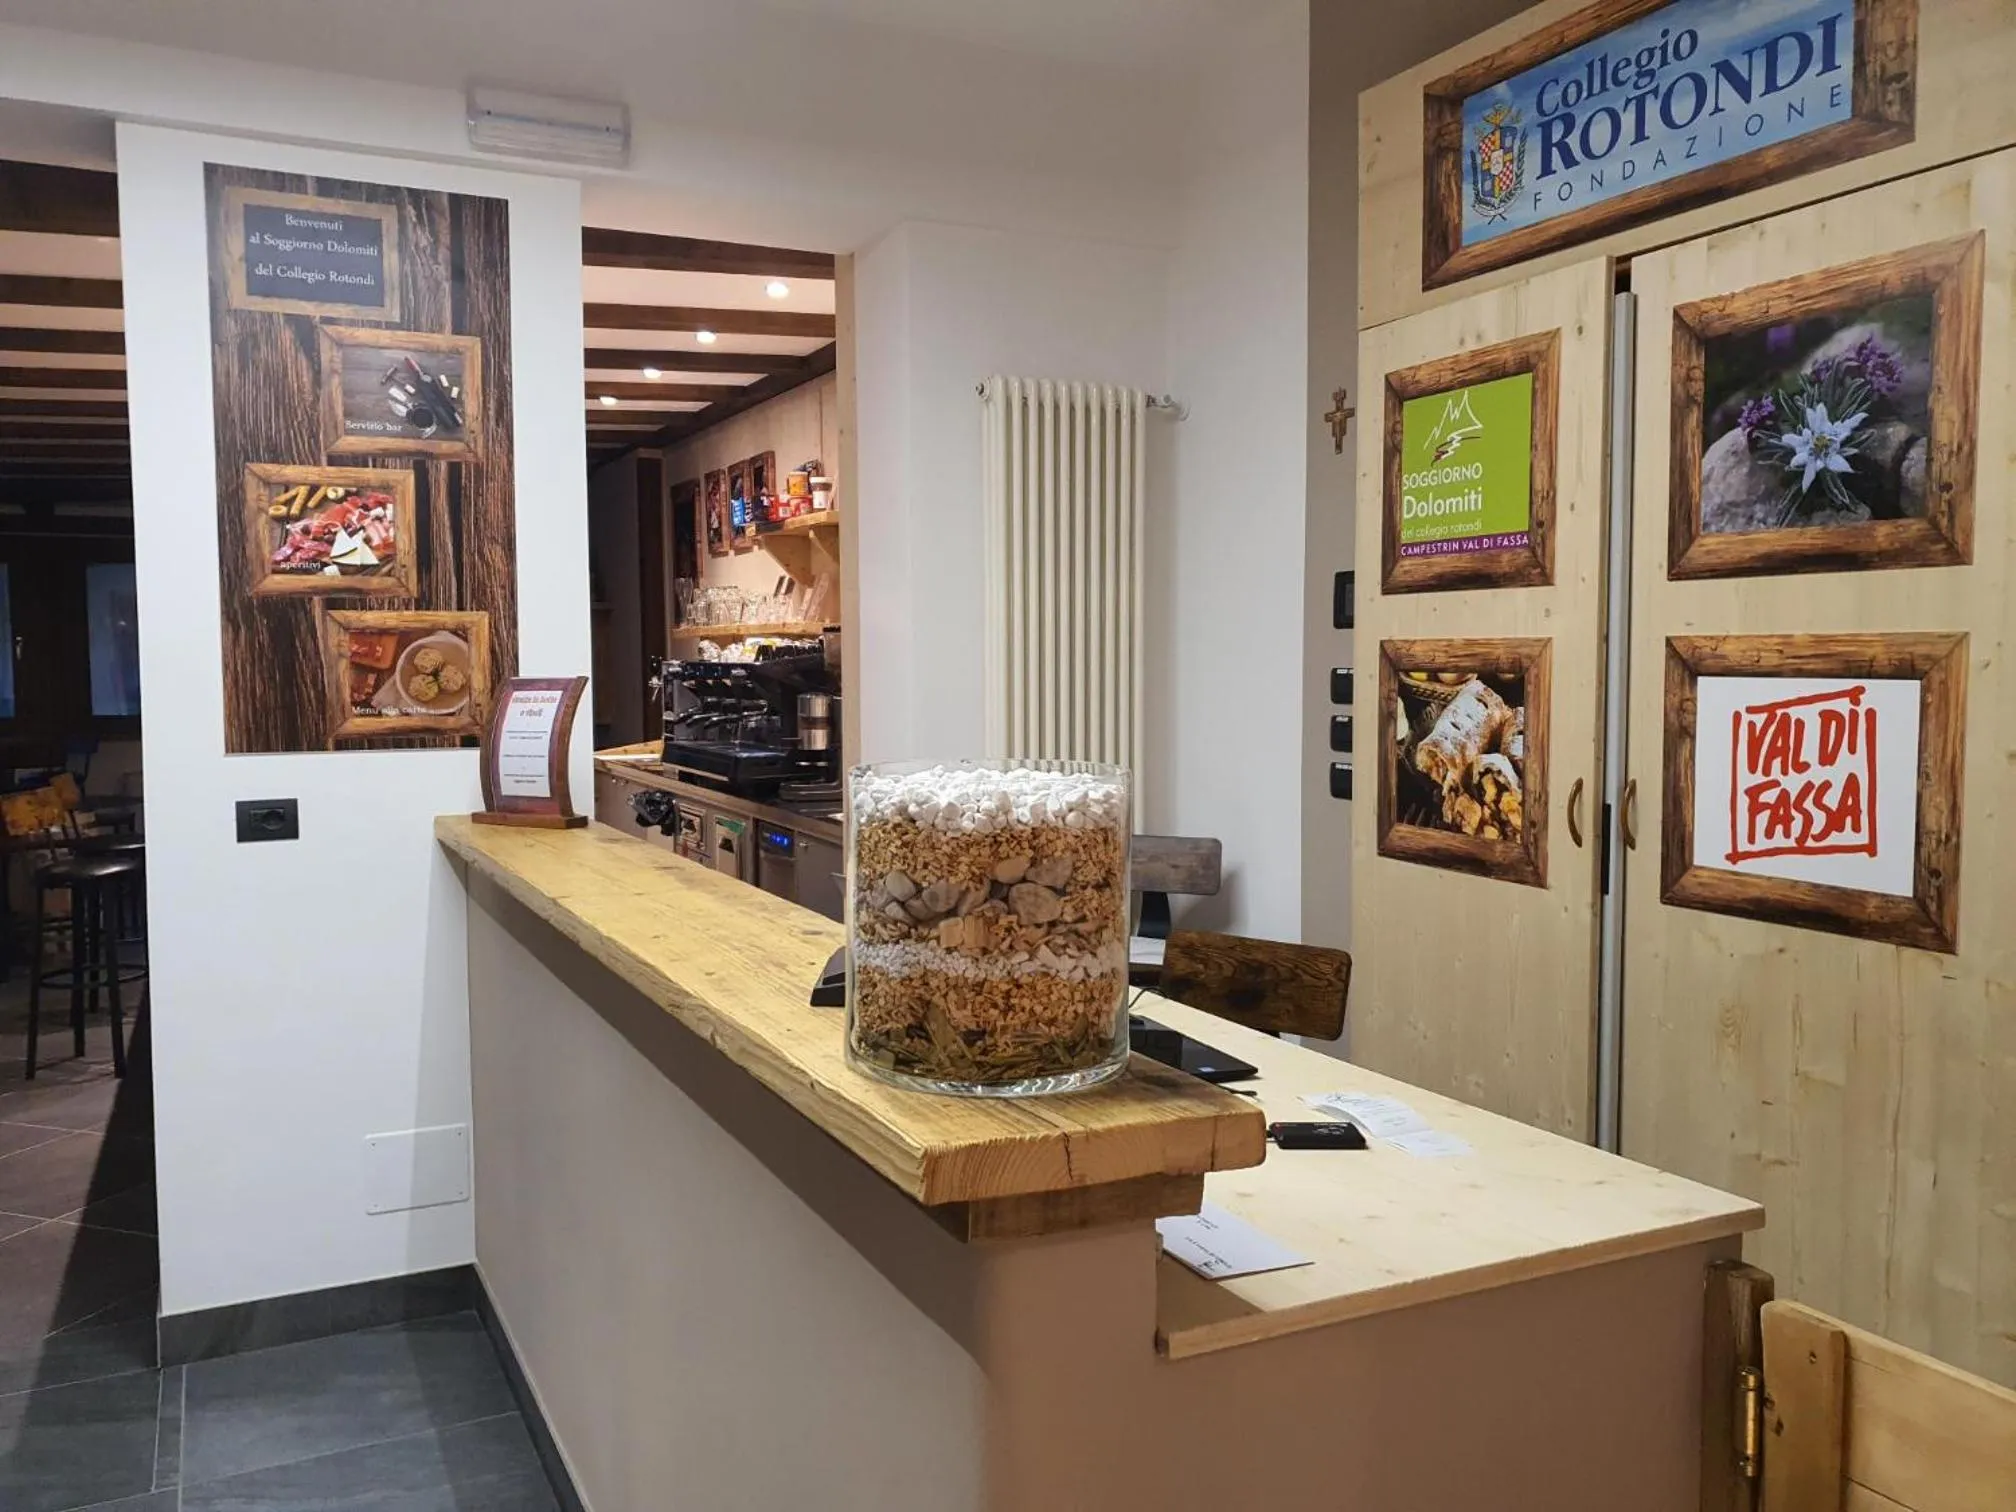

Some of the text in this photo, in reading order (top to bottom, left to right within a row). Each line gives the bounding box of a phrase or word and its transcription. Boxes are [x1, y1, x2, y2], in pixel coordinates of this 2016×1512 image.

[1535, 27, 1699, 118] Collegio
[1535, 12, 1843, 181] ROTONDI
[1532, 82, 1843, 212] FONDAZIONE
[284, 212, 344, 232] Benvenuti
[248, 233, 379, 257] al Soggiorno Dolomiti
[254, 264, 375, 286] del Collegio Rotondi
[1403, 462, 1484, 491] SOGGIORNO
[1403, 486, 1483, 520] Dolomiti
[1416, 524, 1448, 538] collegio
[1450, 519, 1482, 534] rotondi
[1401, 534, 1529, 556] CAMPESTRIN VAL DI FASSA
[1745, 708, 1812, 777] VAL
[1743, 772, 1863, 847] FASSA
